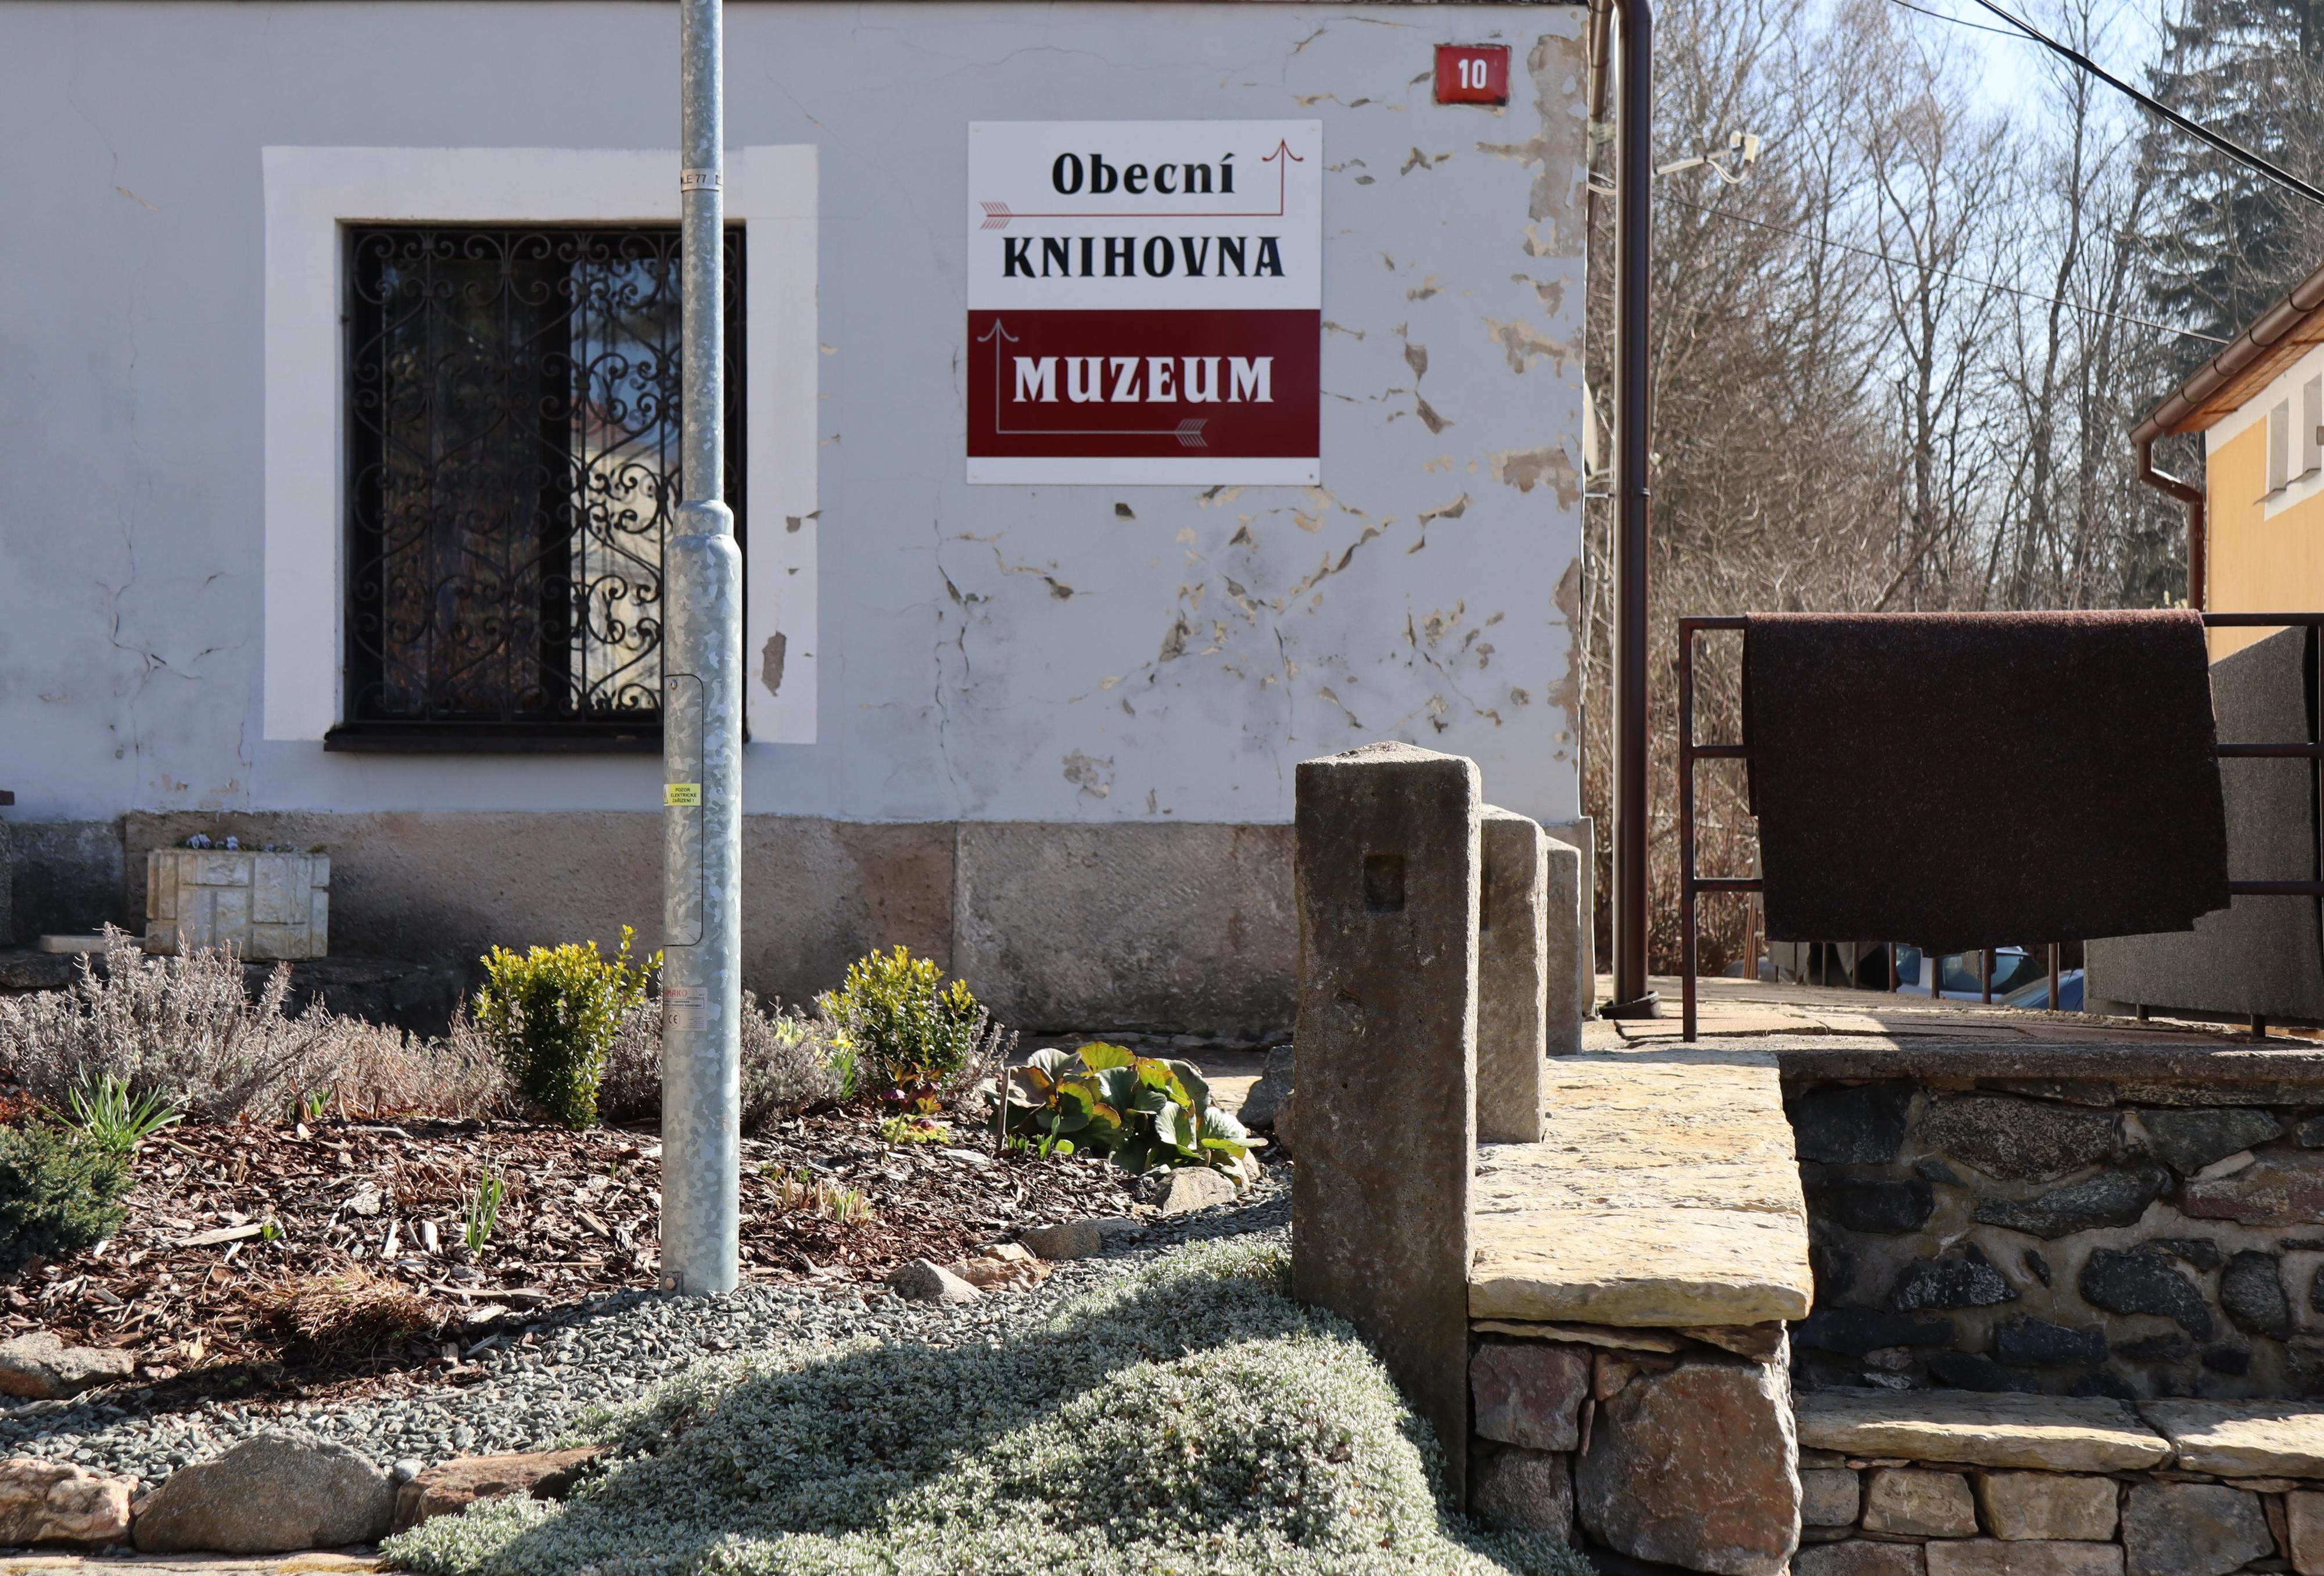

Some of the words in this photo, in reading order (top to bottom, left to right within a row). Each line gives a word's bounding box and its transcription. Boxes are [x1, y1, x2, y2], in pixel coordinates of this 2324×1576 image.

[1458, 59, 1487, 89] 10
[695, 174, 707, 184] 77
[1052, 152, 1236, 195] Obecní
[1002, 235, 1286, 278] KNIHOVNA
[1012, 356, 1275, 403] MUZEUM
